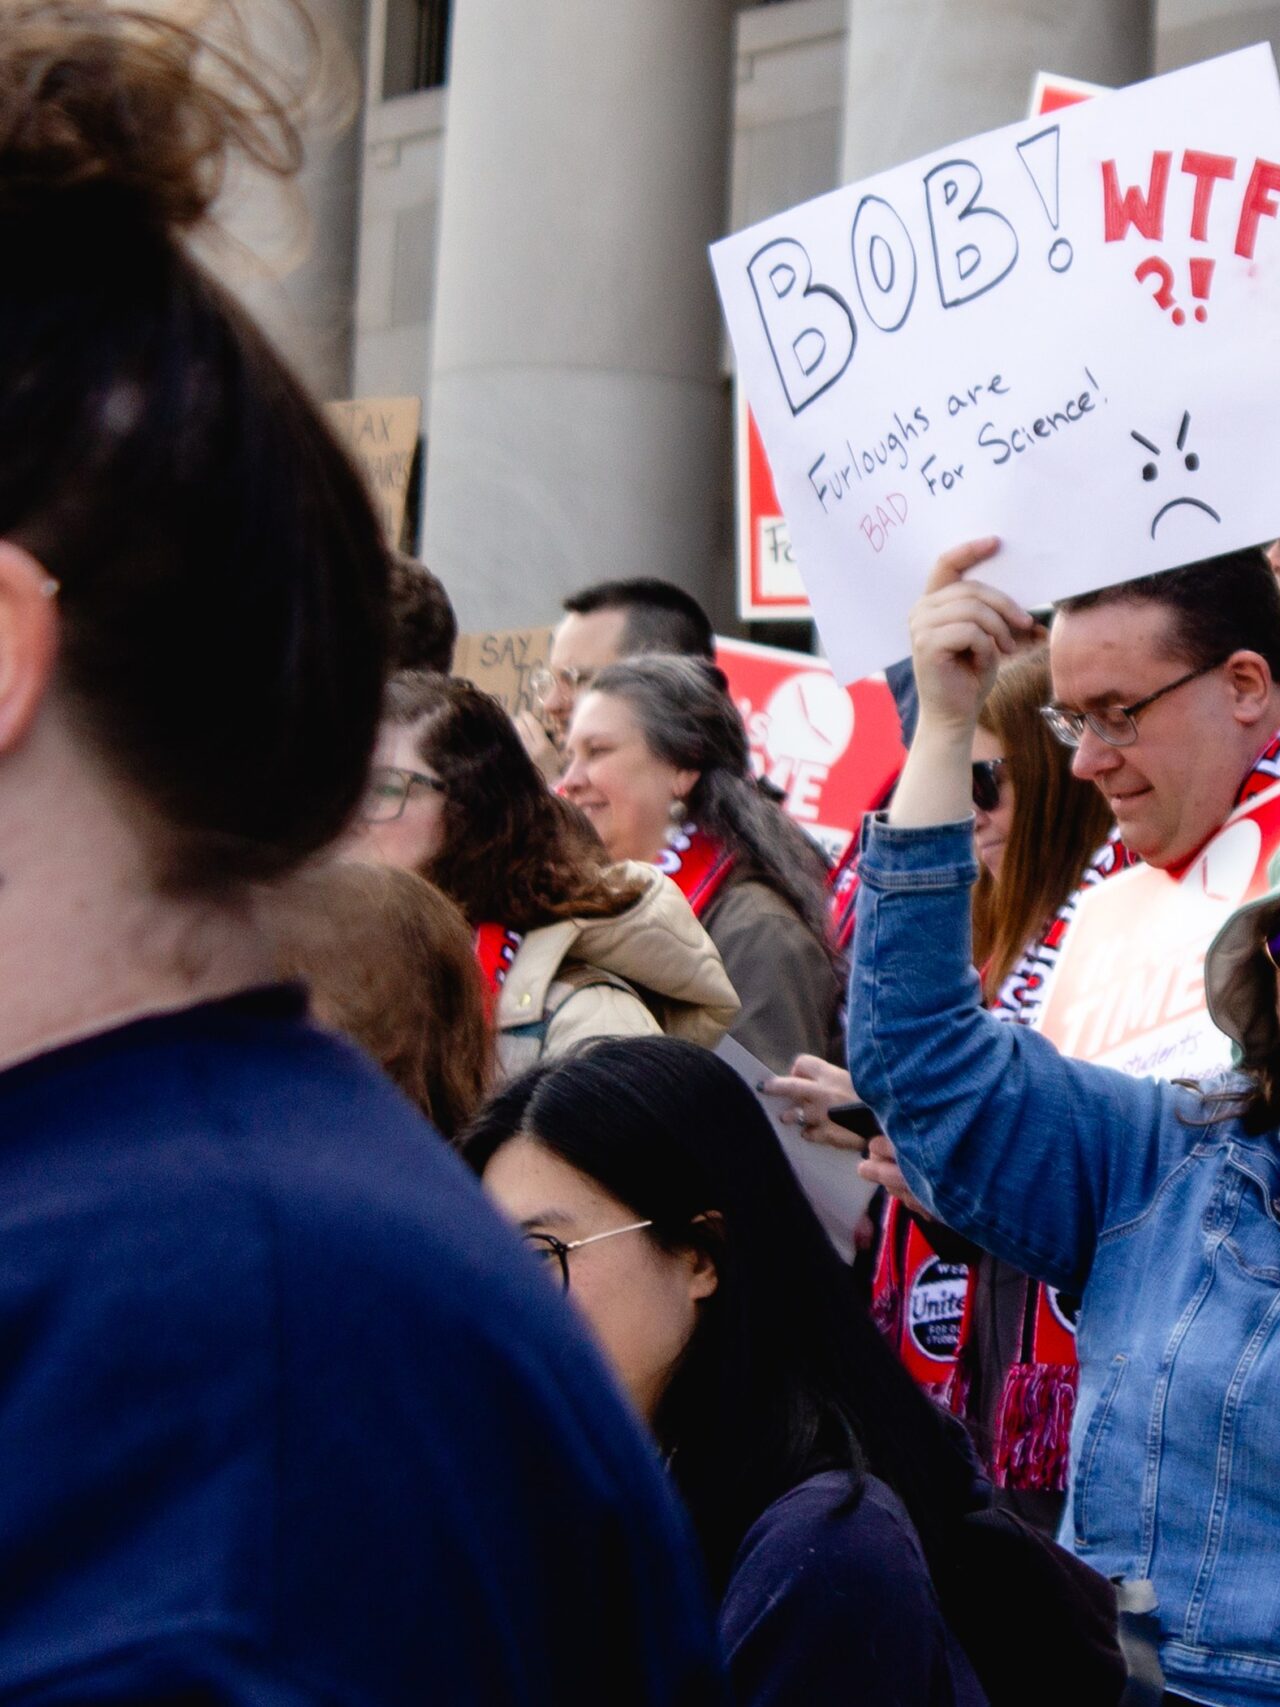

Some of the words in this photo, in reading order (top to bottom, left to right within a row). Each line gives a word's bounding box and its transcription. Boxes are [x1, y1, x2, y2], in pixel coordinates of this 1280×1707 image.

[747, 124, 1073, 416] BOB!
[1134, 255, 1215, 326] ?!
[808, 406, 930, 513] Furloughs
[948, 374, 1010, 416] are
[860, 493, 908, 553] BAD
[480, 635, 532, 667] SAY
